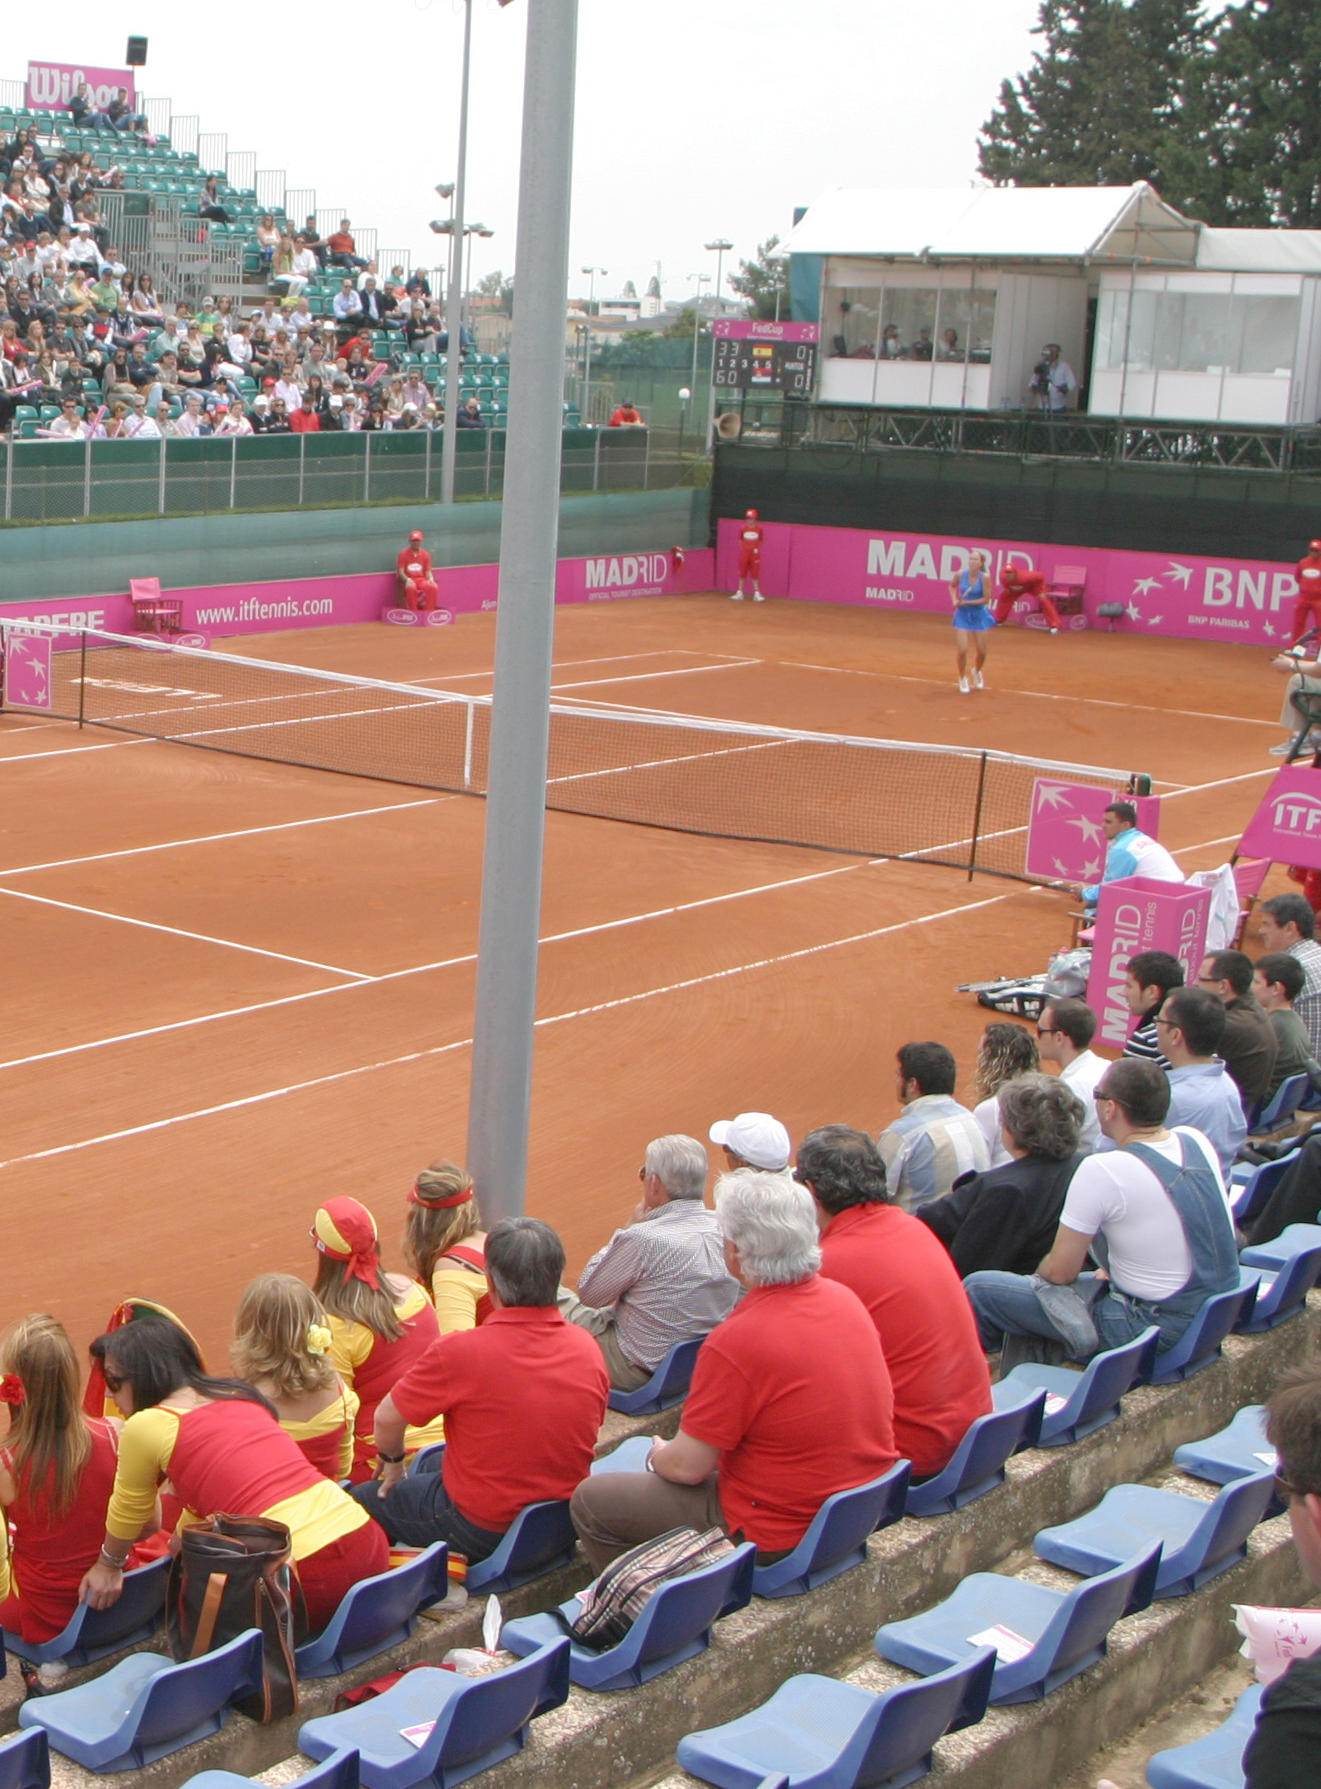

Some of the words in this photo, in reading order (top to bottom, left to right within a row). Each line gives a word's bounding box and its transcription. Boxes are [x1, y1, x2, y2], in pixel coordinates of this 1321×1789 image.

[730, 342, 740, 357] 3
[796, 345, 806, 360] 0
[718, 359, 724, 367] 1
[729, 359, 737, 368] 2
[741, 359, 748, 368] 3
[752, 359, 760, 368] 4
[764, 360, 772, 369] 5
[728, 371, 737, 384] 0
[794, 374, 804, 388] 0
[585, 554, 668, 589] MADRID
[865, 586, 915, 602] MADRID
[1203, 566, 1300, 612] BNP
[195, 596, 333, 625] www.itftennis.com
[1187, 614, 1208, 625] BNP
[1209, 615, 1251, 629] PARIBAS
[1274, 803, 1321, 831] ITF
[1142, 901, 1158, 942] tennis
